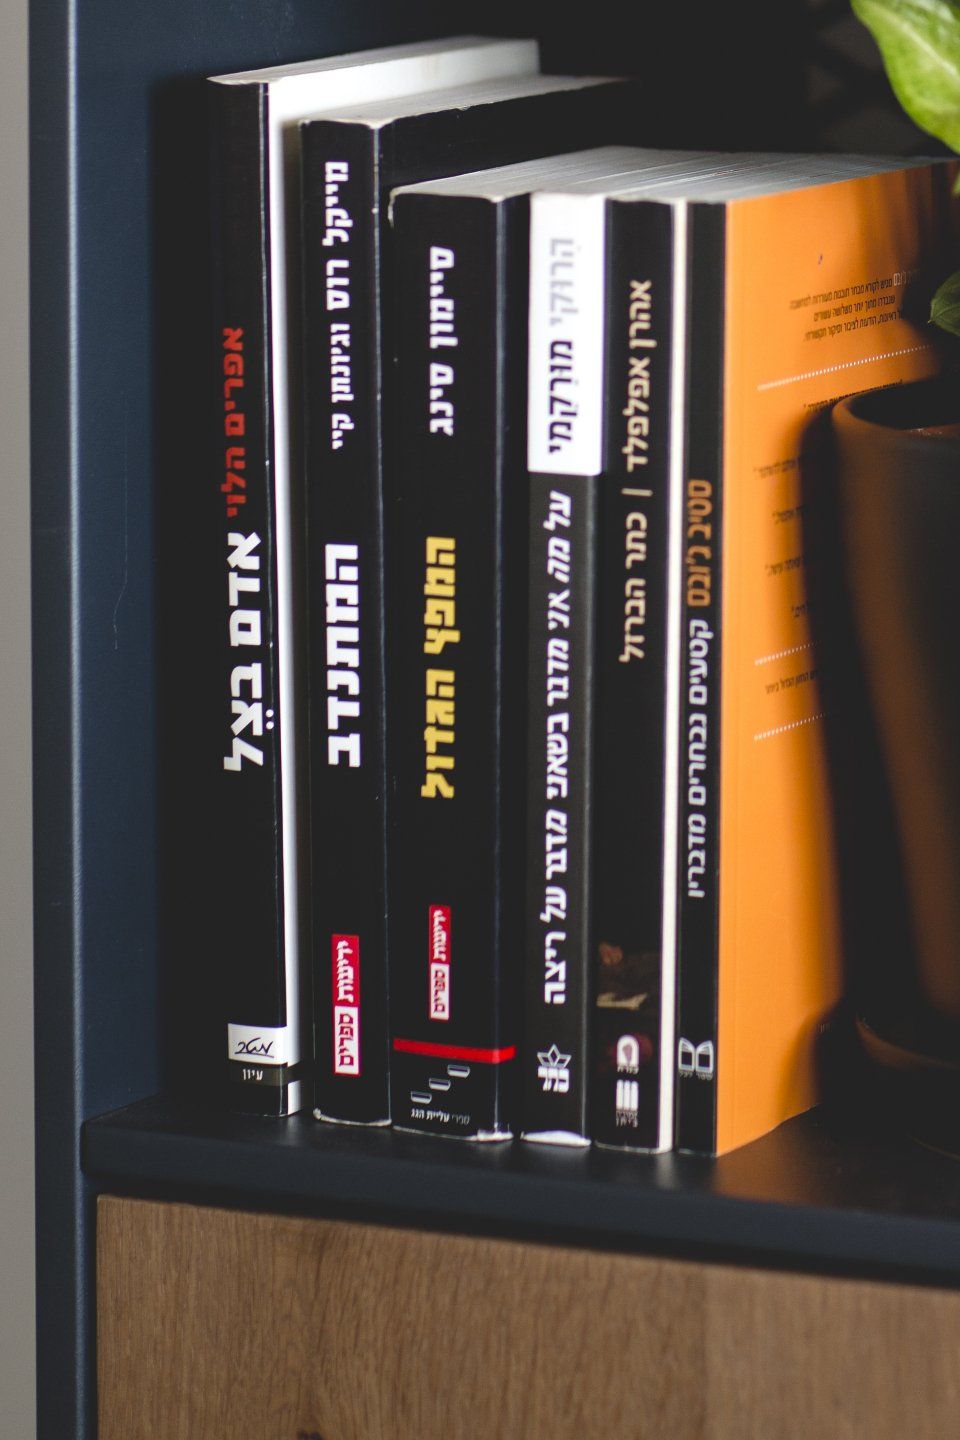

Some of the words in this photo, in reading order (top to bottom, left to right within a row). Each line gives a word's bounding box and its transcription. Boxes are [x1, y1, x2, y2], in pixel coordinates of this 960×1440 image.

[322, 161, 353, 247] מייקל
[326, 259, 350, 310] רוס
[429, 246, 458, 349] סיימון
[629, 279, 657, 350] אהרן
[223, 327, 246, 437] אפרים
[429, 362, 454, 436] סינג
[622, 357, 651, 473] אפלפלד
[331, 413, 354, 450] קיי
[220, 447, 247, 518] הלוי
[543, 490, 572, 531] על
[687, 479, 712, 540] סטיב
[547, 536, 571, 583] מה
[625, 512, 648, 570] כתר
[227, 531, 261, 647] אדם
[423, 536, 460, 655] המפץ
[547, 589, 570, 631] אני
[619, 578, 647, 663] הברזל
[325, 543, 361, 768] המתנדב
[547, 638, 570, 707] מדבר
[688, 619, 714, 707] קטעים
[420, 668, 455, 799] הגדול
[688, 714, 708, 807] נבחרים
[544, 809, 569, 880] מדבר
[687, 814, 708, 897] מדבריו
[433, 910, 447, 962] ידיעות
[540, 885, 568, 924] על
[336, 940, 354, 1003] ידיעות
[433, 968, 446, 1015] ספרים
[544, 931, 567, 1005] ריצה
[338, 1012, 354, 1067] ספרים
